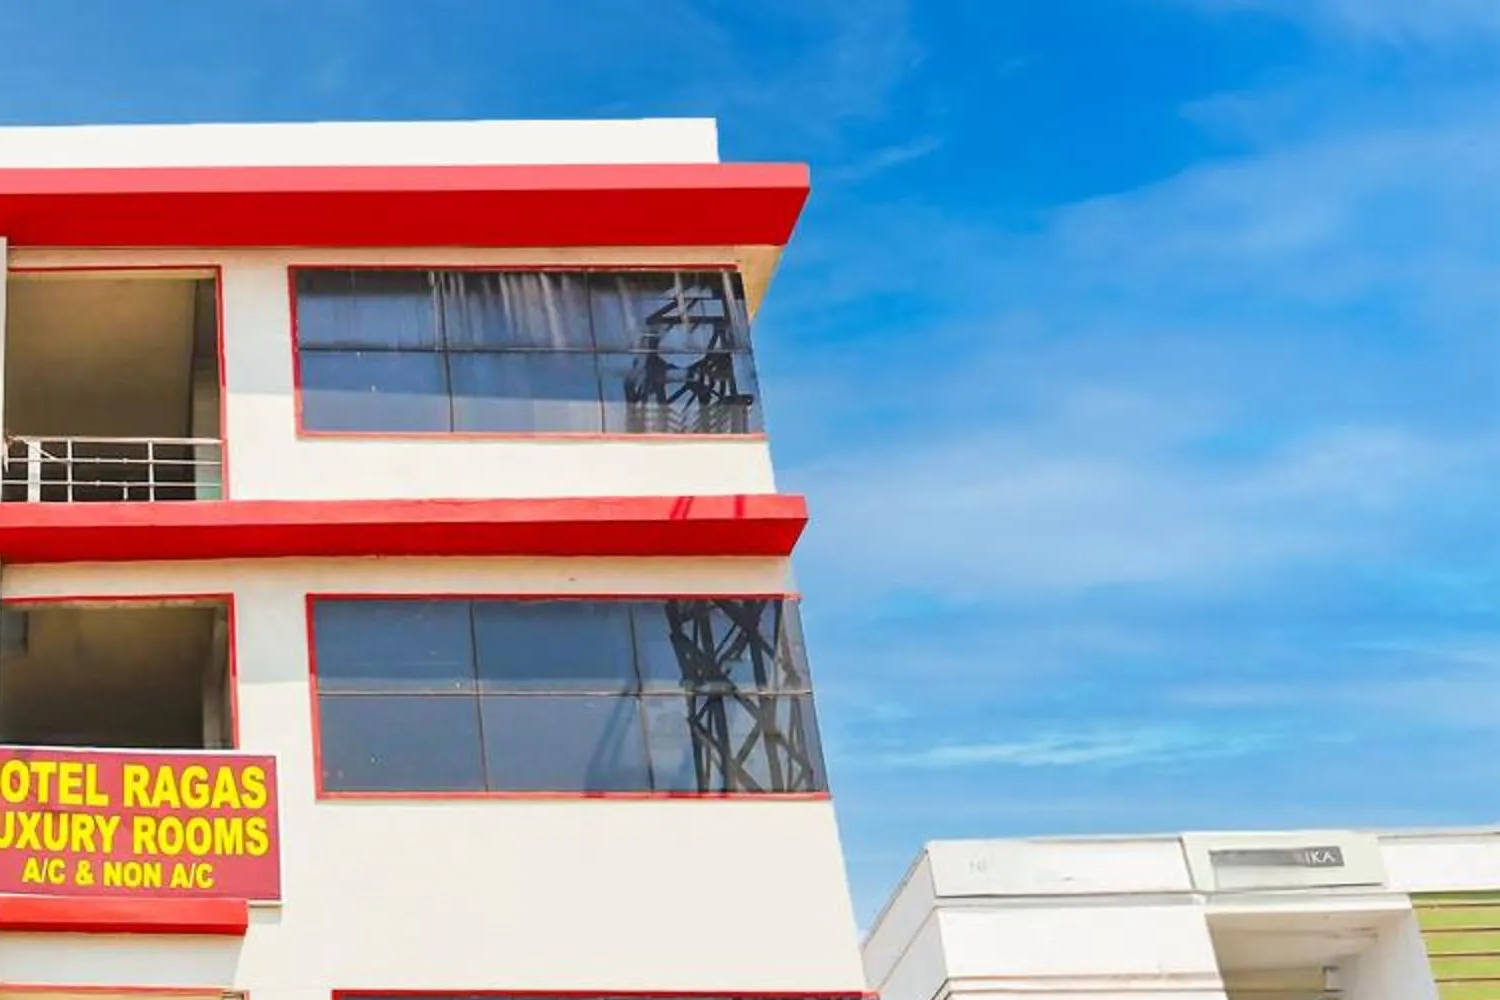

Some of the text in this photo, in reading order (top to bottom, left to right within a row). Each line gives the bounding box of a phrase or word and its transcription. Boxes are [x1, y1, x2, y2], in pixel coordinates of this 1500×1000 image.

[122, 763, 268, 809] RAGAS
[133, 815, 269, 856] ROOMS
[21, 857, 215, 889] A/C & NON A/C
